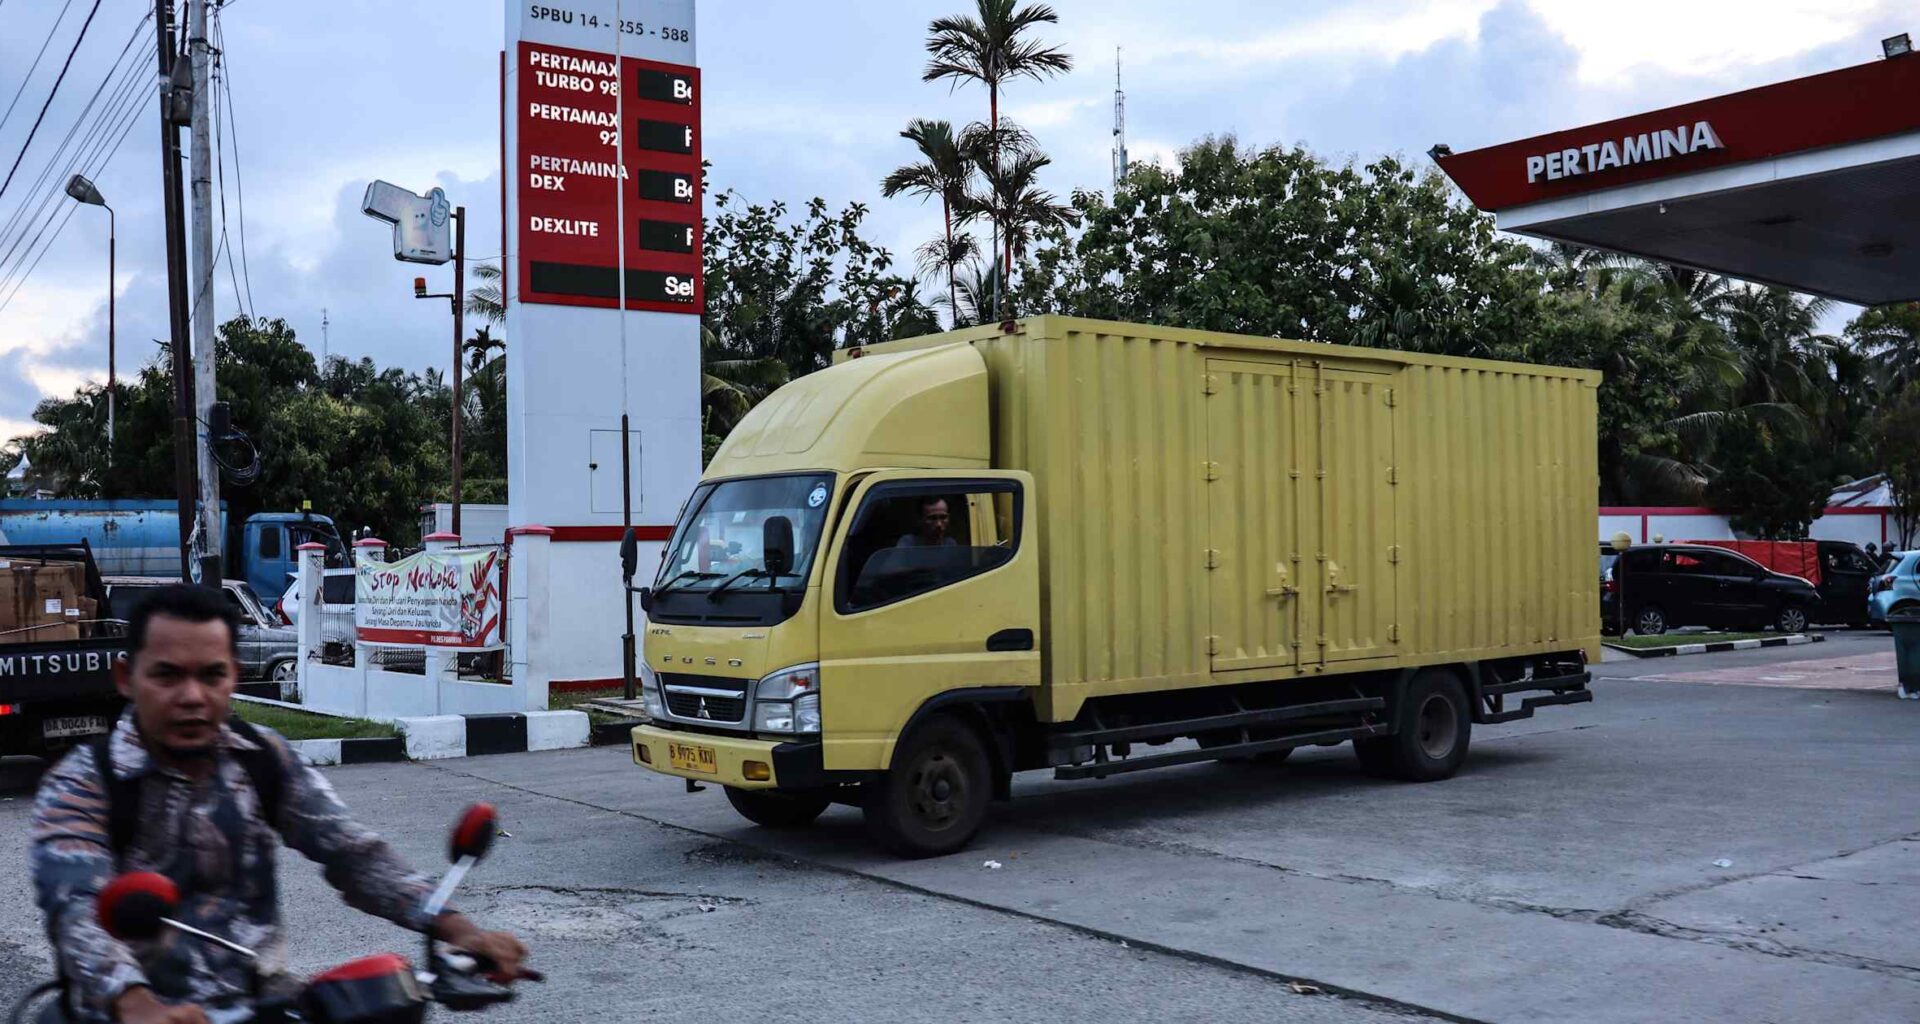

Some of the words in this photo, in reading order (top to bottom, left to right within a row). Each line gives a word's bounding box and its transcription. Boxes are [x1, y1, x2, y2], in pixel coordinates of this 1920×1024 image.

[531, 5, 573, 24] SPBU
[580, 13, 598, 28] 14
[619, 20, 644, 36] 255
[661, 27, 689, 43] 588
[530, 51, 618, 78] PERTAMAX
[536, 70, 594, 93] TURBO
[600, 80, 618, 96] 98
[530, 102, 618, 128] PERTAMAX
[600, 131, 619, 146] 92
[1526, 121, 1725, 184] PERTAMINA
[530, 154, 629, 180] PERTAMINA
[530, 173, 565, 191] DEX
[530, 216, 599, 237] DEXLITE
[663, 655, 743, 667] FUSO
